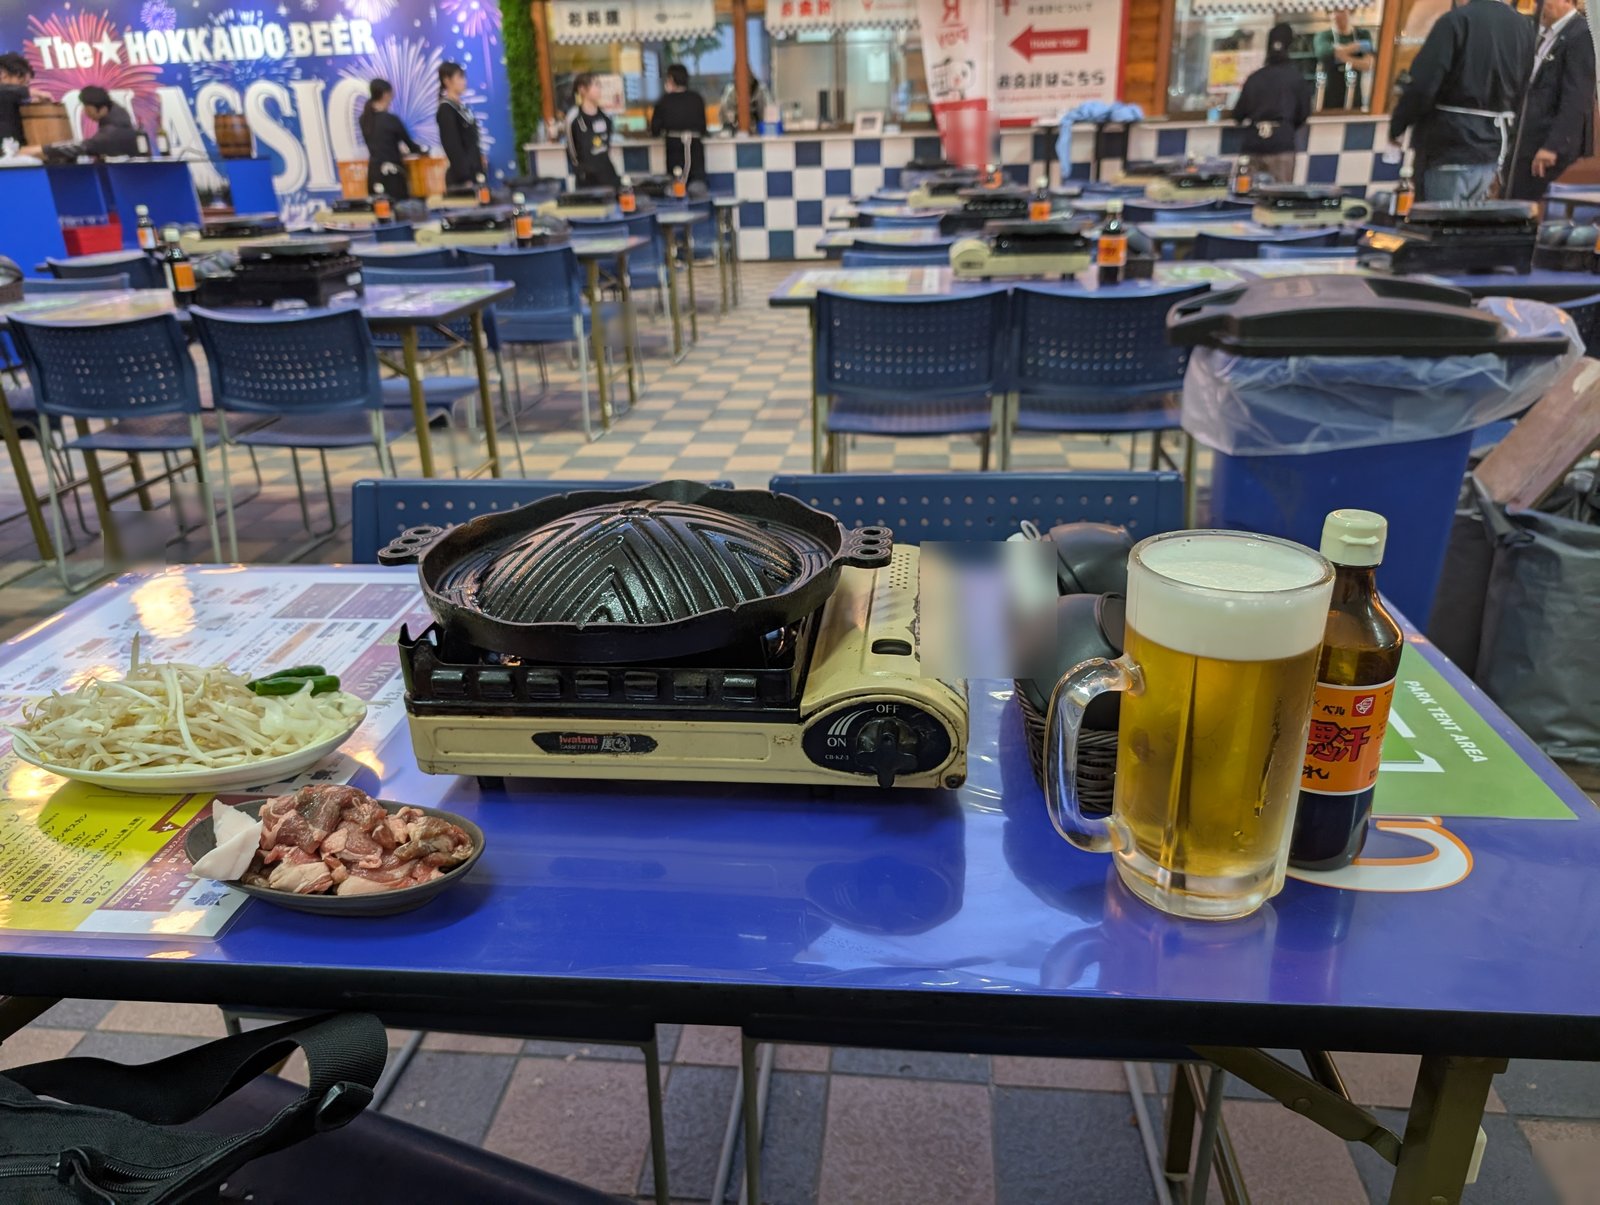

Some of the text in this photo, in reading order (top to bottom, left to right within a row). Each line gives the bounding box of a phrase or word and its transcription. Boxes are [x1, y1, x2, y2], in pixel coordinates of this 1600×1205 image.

[33, 19, 376, 70] The HOKKAIDO BEER
[875, 704, 900, 714] OFF
[1322, 704, 1346, 716] ベル
[1403, 680, 1489, 762] PARK TENT AREA
[559, 735, 598, 744] Iwatani
[827, 736, 847, 748] ON
